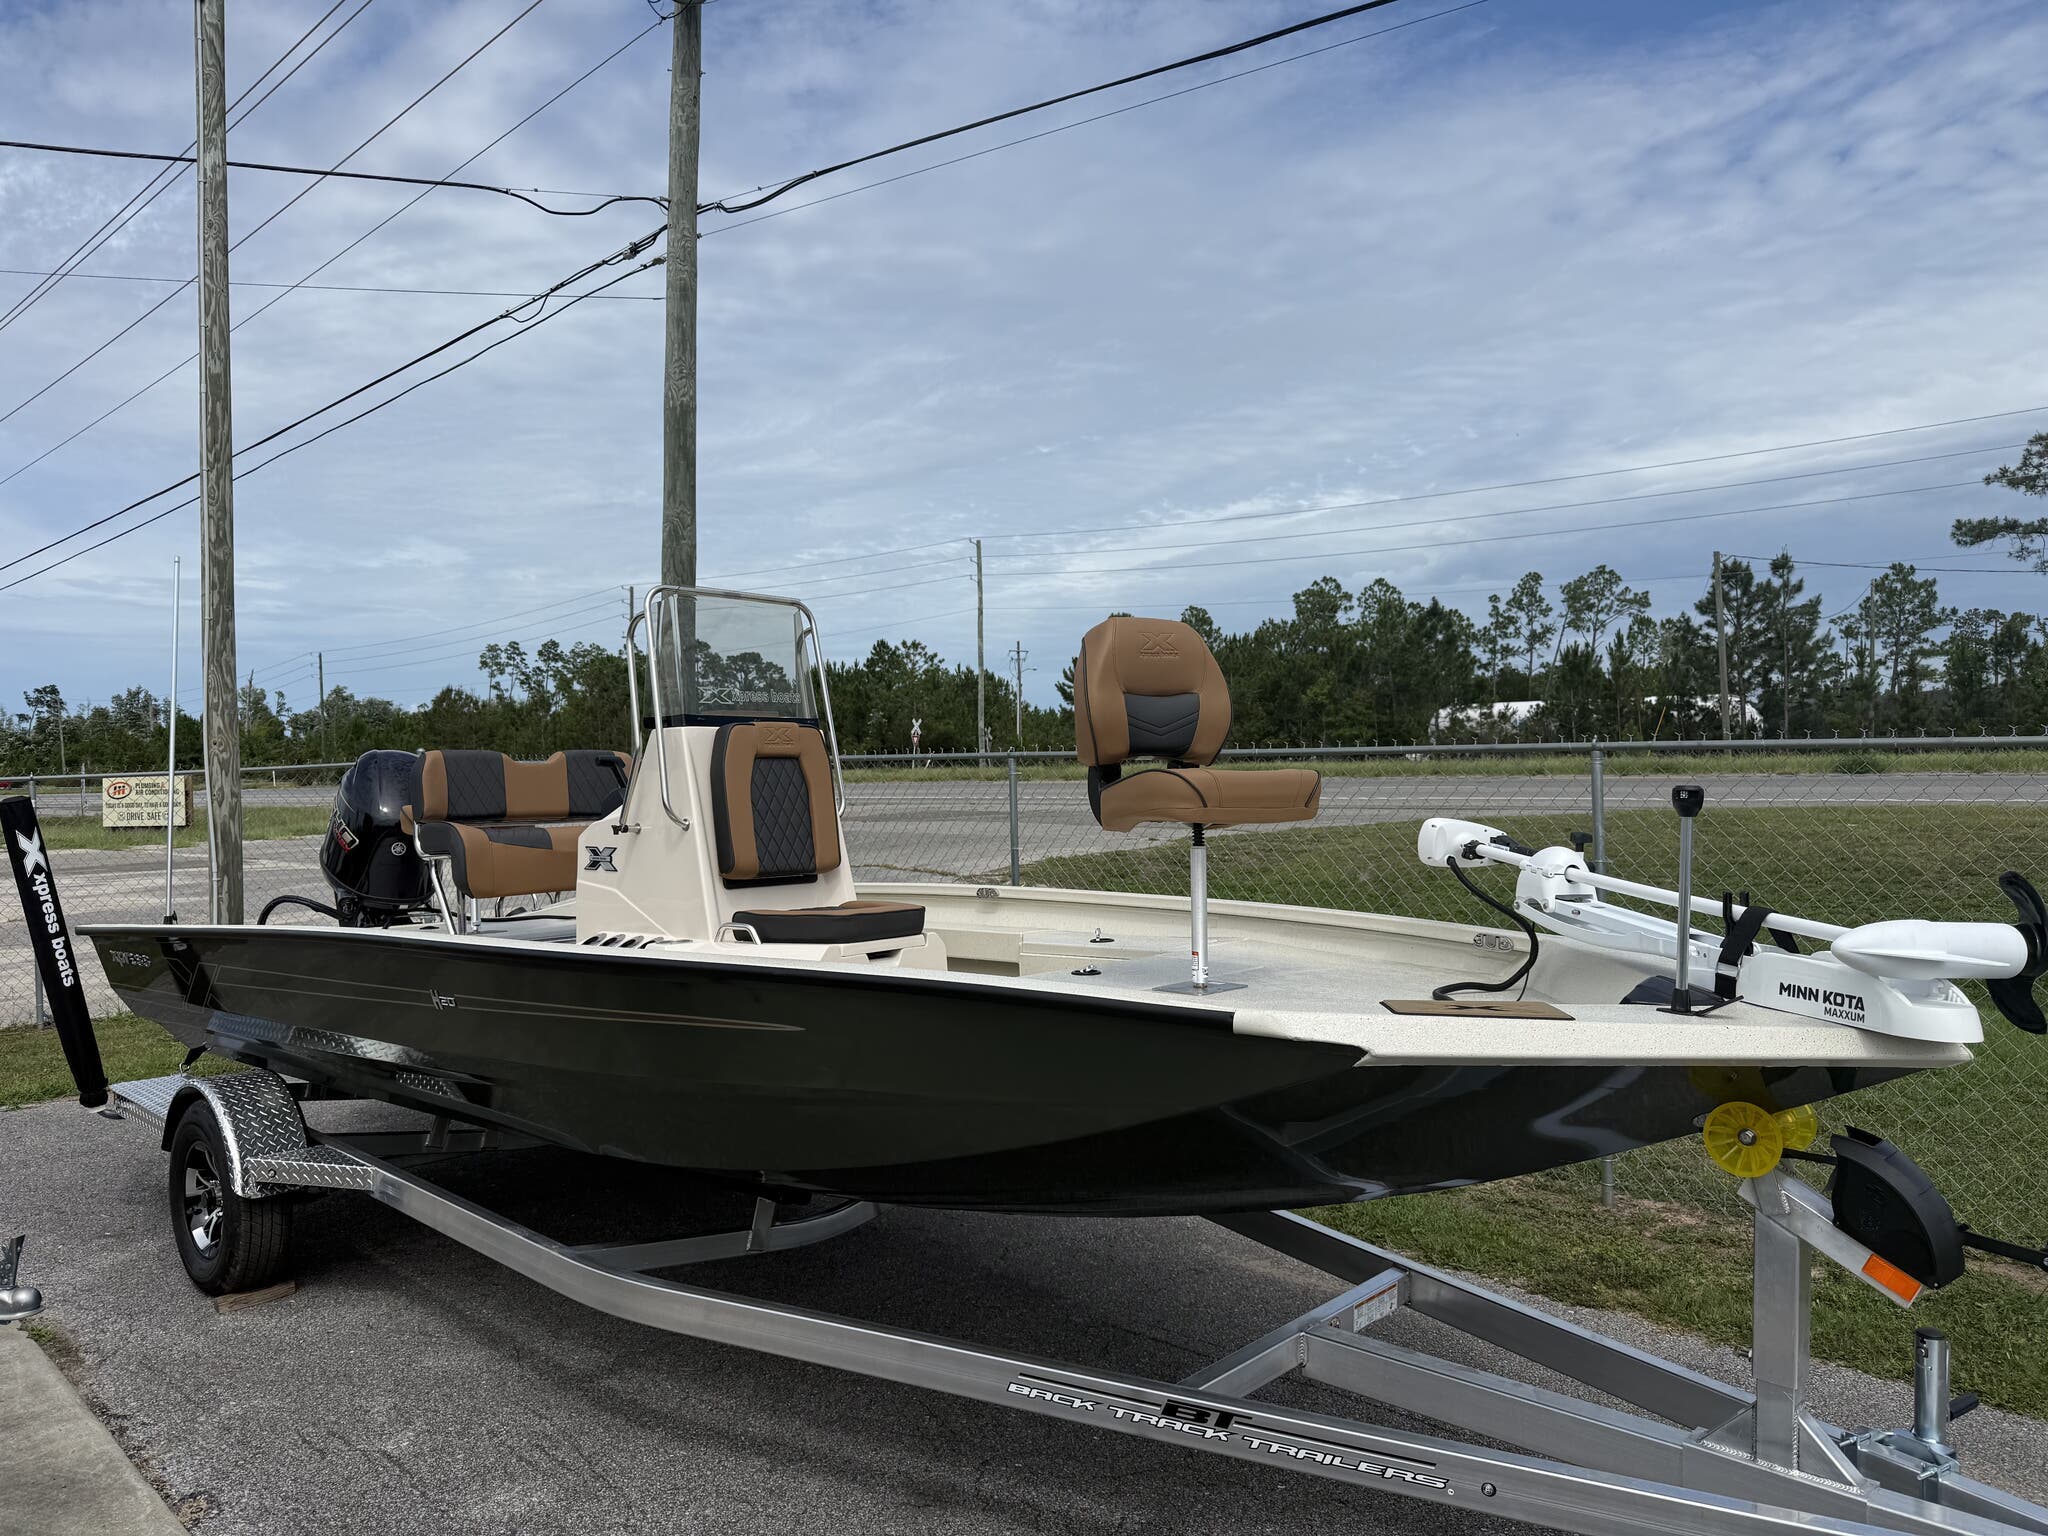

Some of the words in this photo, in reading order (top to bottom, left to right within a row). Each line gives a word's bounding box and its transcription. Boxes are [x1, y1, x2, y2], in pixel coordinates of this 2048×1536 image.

[126, 812, 144, 820] DRIVE
[147, 812, 161, 820] SAFE
[51, 936, 74, 987] boats
[1779, 982, 1819, 1003] MINN
[1822, 990, 1865, 1012] KOTA
[1823, 1006, 1865, 1023] MAXXUM
[1161, 1399, 1252, 1428] BT
[1007, 1382, 1102, 1411] BACK
[1108, 1405, 1236, 1442] TRACK
[1242, 1434, 1449, 1489] TRAILERS
